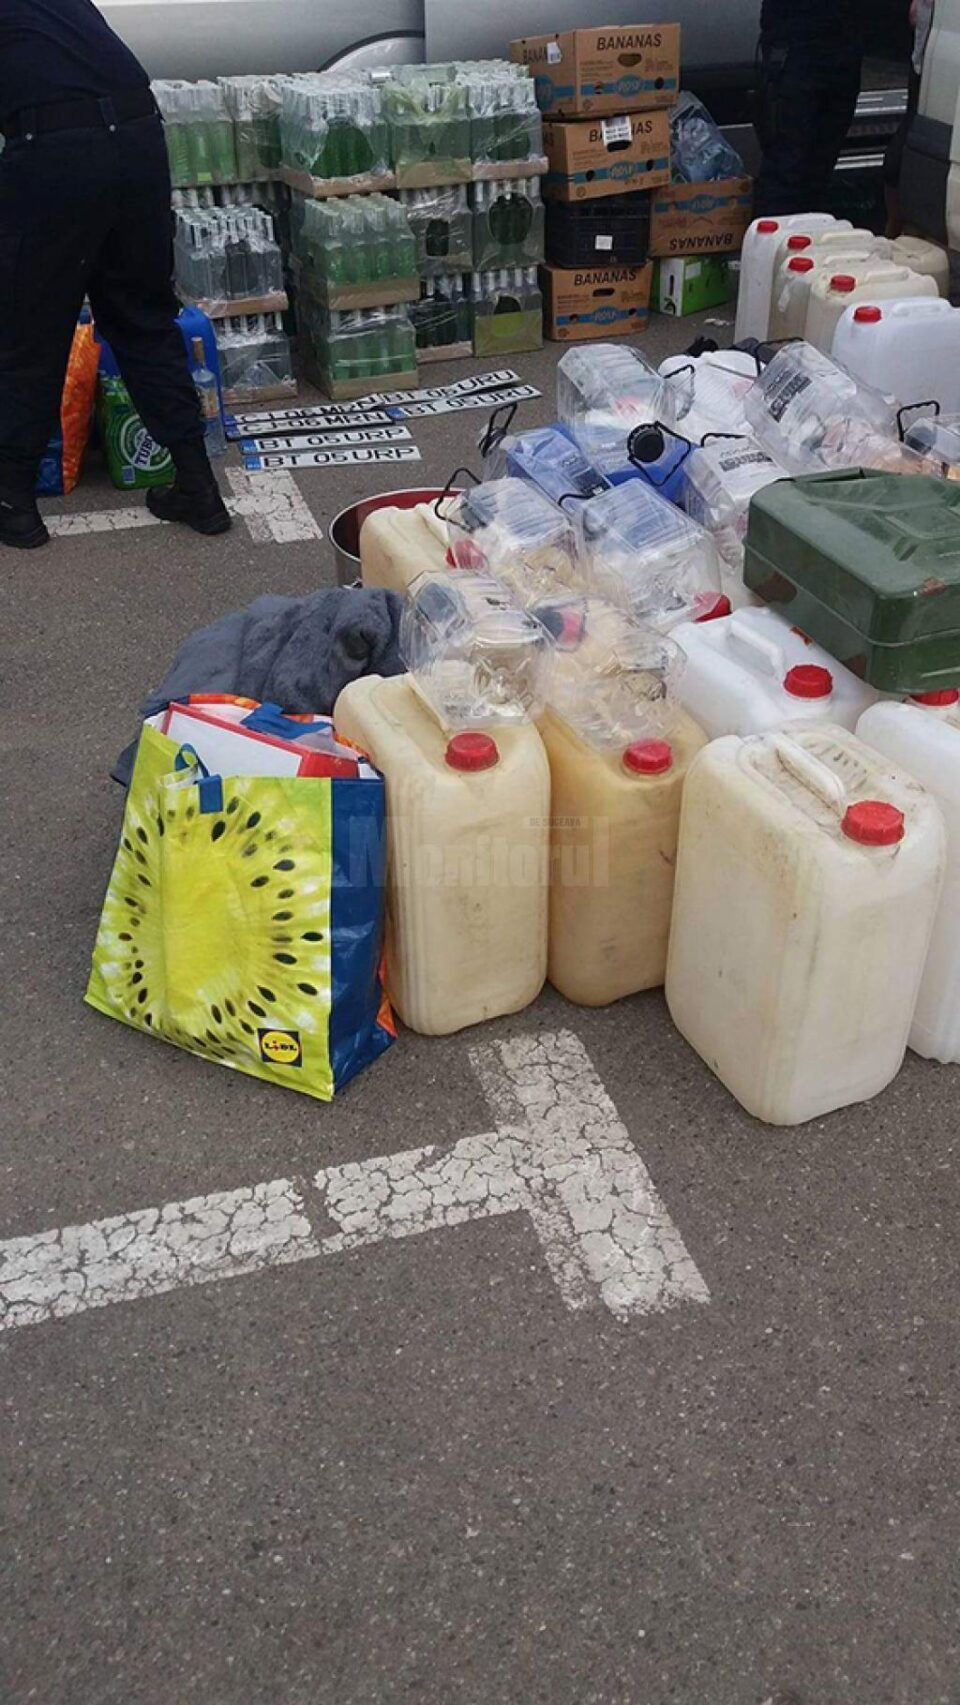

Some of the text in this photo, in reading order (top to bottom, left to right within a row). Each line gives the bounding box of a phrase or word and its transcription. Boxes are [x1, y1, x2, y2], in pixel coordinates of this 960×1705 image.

[597, 33, 662, 51] BANANAS
[670, 233, 734, 251] BANANAS
[574, 269, 637, 286] BANANAS
[324, 411, 384, 425] MRN
[403, 403, 437, 416] BT
[258, 427, 404, 449] BT 05 URP
[263, 446, 415, 467] BT 05 URP
